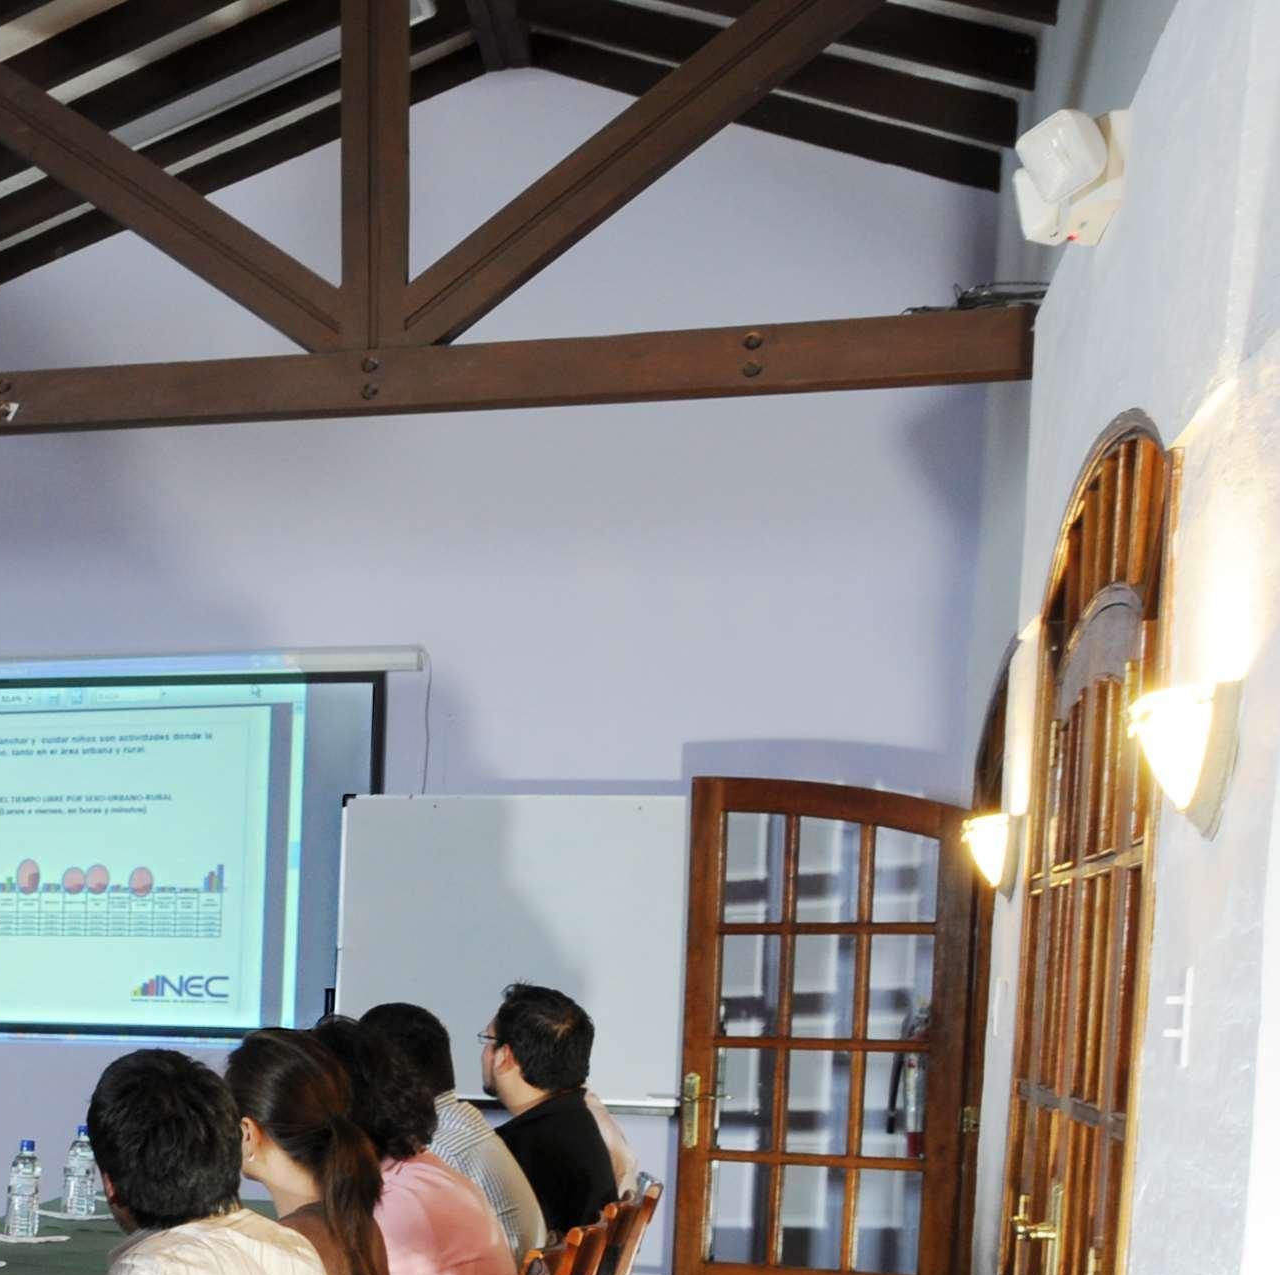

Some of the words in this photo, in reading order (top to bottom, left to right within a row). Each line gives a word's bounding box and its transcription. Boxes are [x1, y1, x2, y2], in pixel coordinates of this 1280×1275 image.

[118, 732, 170, 742] actividades
[173, 730, 202, 740] donde
[155, 974, 230, 998] INEC
